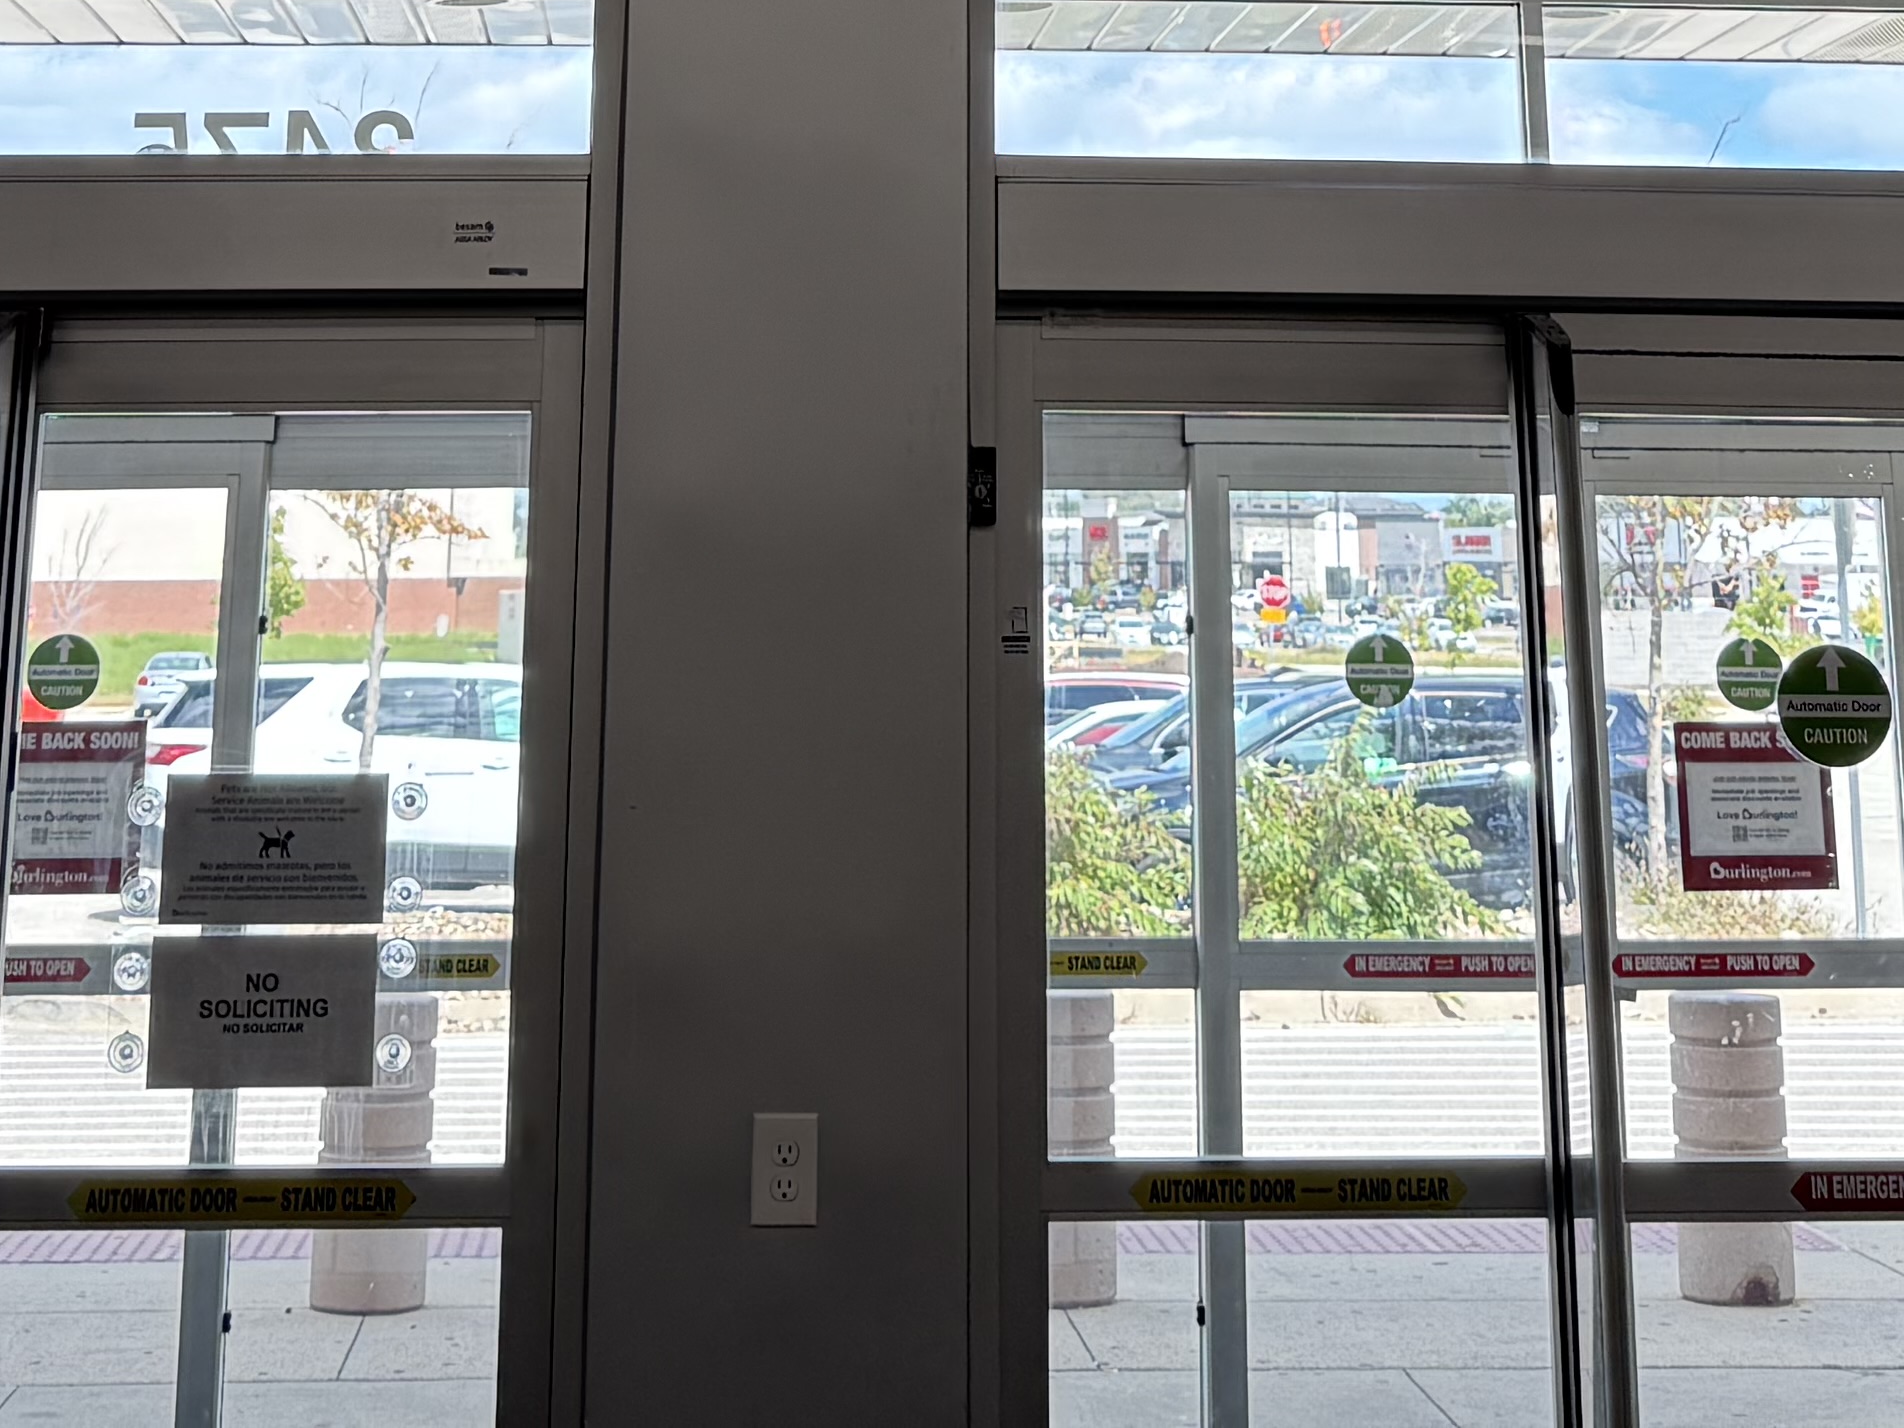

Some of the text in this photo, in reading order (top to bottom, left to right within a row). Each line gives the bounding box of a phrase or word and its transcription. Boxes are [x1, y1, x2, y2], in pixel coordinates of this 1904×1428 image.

[41, 685, 83, 696] CAUTION
[1731, 687, 1770, 698] CAUTION
[1787, 700, 1881, 712] Automatic Door
[42, 732, 139, 750] BACK SOON!
[1681, 731, 1726, 749] COME
[1730, 731, 1773, 749] BACK
[1805, 728, 1868, 744] CAUTION
[30, 960, 44, 976] TO
[46, 959, 75, 976] OPEN
[418, 955, 489, 974] STAND CLEAR
[1067, 954, 1136, 972] STAND CLEAR
[1355, 956, 1365, 972] IN
[1368, 956, 1430, 973] EMERGENCY
[1461, 955, 1488, 973] PUSH
[1491, 956, 1505, 973] TO
[1508, 956, 1534, 973] OPEN
[1622, 956, 1632, 972] IN
[1635, 955, 1696, 972] EMERGENCY
[1726, 954, 1753, 971] PUSH
[1756, 954, 1769, 971] TO
[1772, 954, 1800, 971] OPEN
[245, 973, 279, 993] NO
[199, 998, 329, 1019] SOLICITING
[222, 1022, 304, 1035] NO SOLICITAR
[1149, 1177, 1449, 1203] AUTOMATIC DOOR STAND CLEAR
[1811, 1175, 1827, 1199] IN
[85, 1186, 396, 1214] AUTOMATIC DOOR STAND CLEAR
